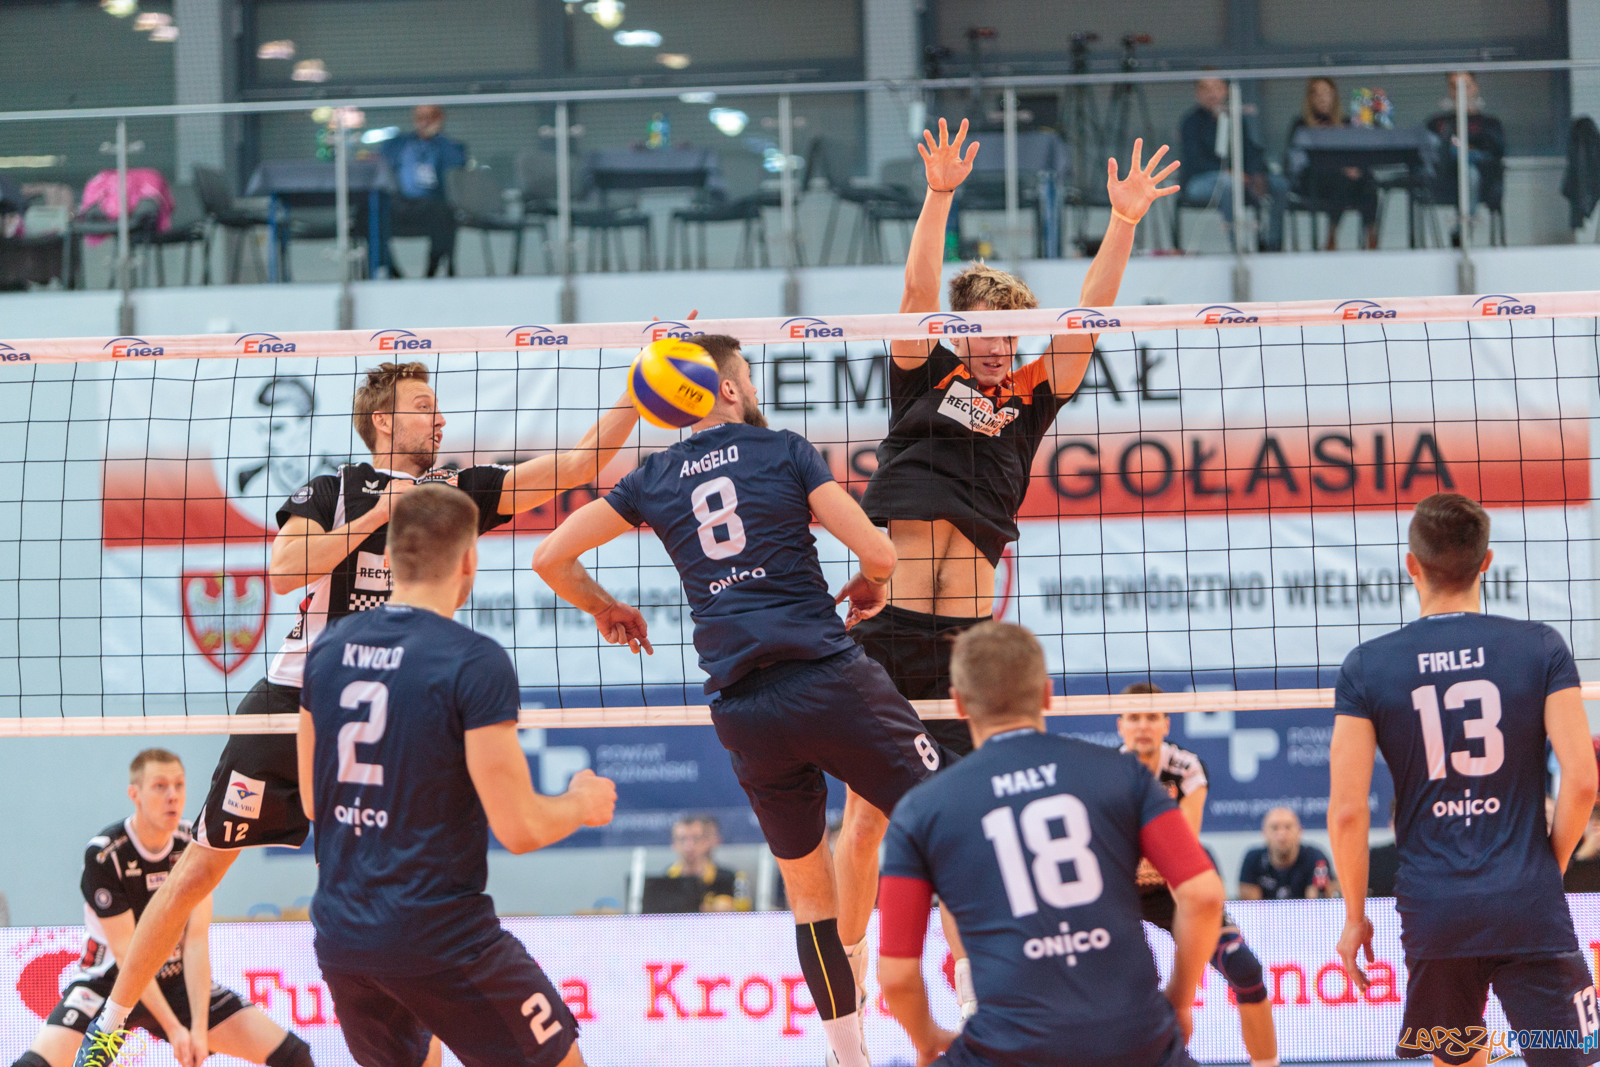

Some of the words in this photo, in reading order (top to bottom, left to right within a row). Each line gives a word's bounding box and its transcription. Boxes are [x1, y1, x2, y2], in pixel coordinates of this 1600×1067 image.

[1204, 313, 1259, 325] Enea
[1342, 308, 1397, 320] Enea
[1482, 302, 1536, 316] Enea
[789, 325, 843, 339] Enea
[928, 321, 982, 335] Enea
[1067, 316, 1121, 329] Enea
[243, 340, 296, 354] Enea
[378, 337, 432, 350] Enea
[515, 333, 568, 347] Enea
[0, 352, 32, 362] nea
[111, 345, 164, 358] Enea
[680, 445, 739, 478] ANGELO
[1048, 431, 1455, 499] GOŁASIA
[691, 476, 746, 561] 8
[1040, 566, 1266, 614] WOJEWÓDZTWO
[1417, 646, 1485, 674] FIRLEJ
[337, 680, 389, 786] 2
[1411, 679, 1505, 781] 13
[914, 733, 939, 771] 8
[990, 763, 1057, 798] MAŁY
[222, 821, 249, 842] 12
[981, 793, 1104, 918] 18
[62, 1009, 79, 1026] 9
[520, 992, 562, 1045] 2
[1573, 985, 1600, 1040] 13
